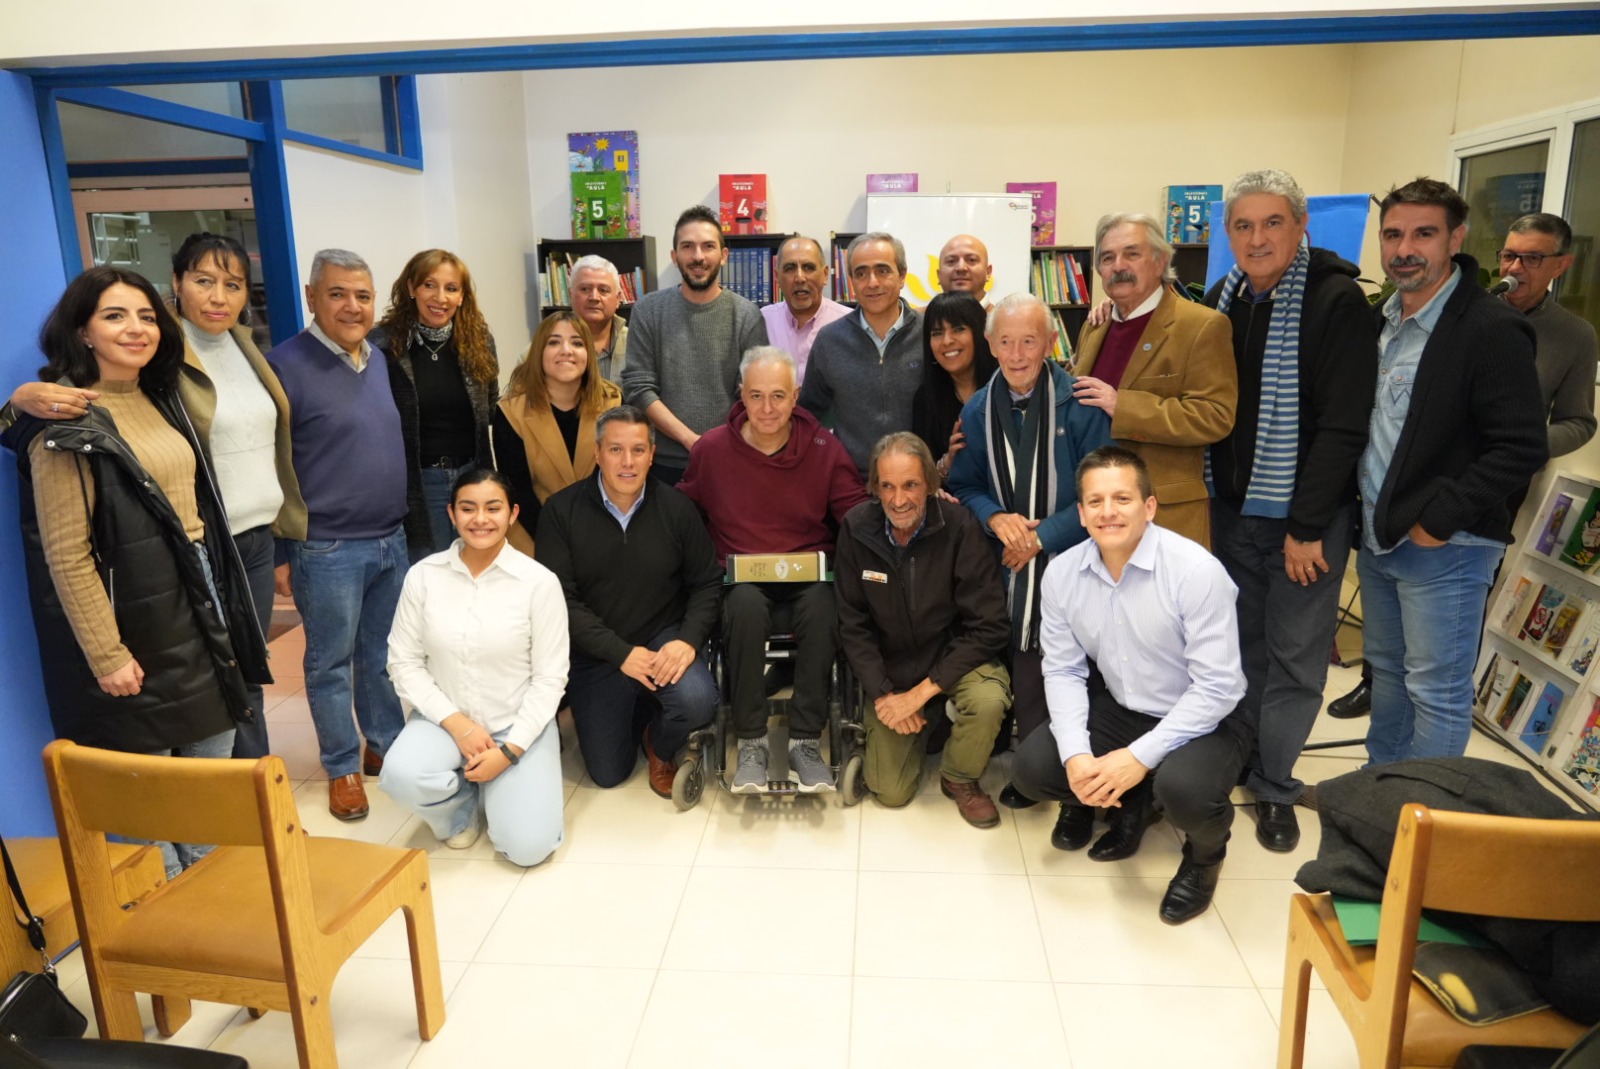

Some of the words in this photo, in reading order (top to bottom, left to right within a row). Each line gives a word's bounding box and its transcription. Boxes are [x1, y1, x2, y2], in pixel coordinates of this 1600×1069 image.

[592, 200, 604, 219] 5
[736, 198, 750, 217] 4
[1188, 205, 1201, 224] 5
